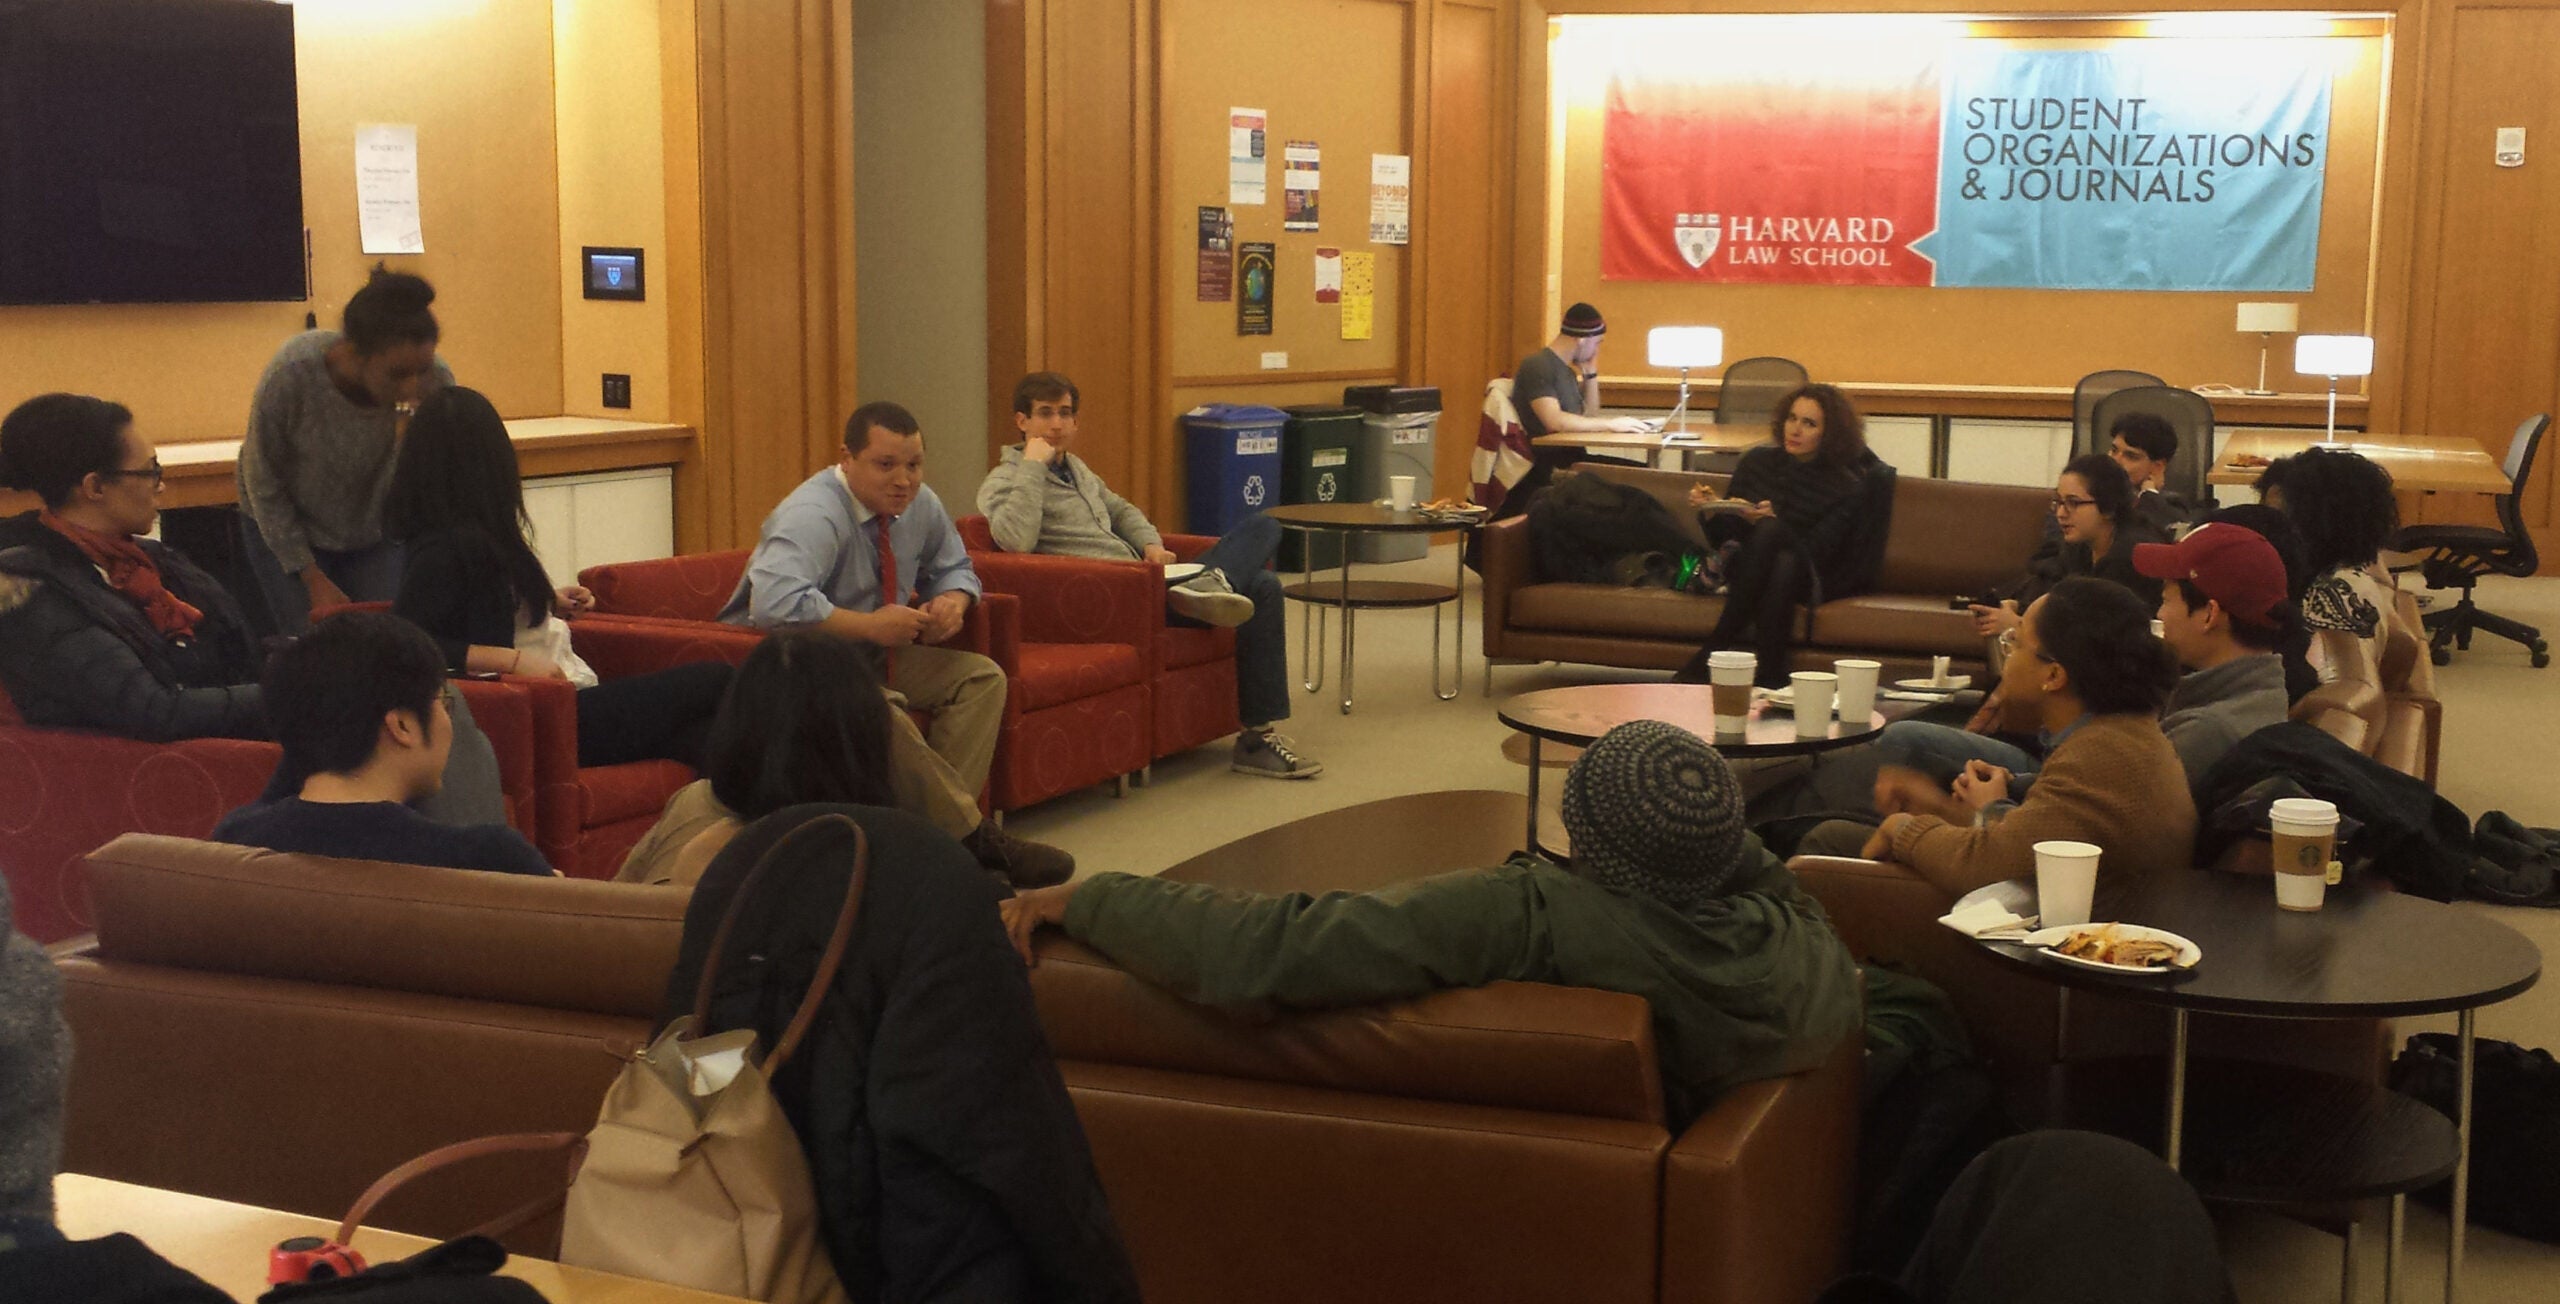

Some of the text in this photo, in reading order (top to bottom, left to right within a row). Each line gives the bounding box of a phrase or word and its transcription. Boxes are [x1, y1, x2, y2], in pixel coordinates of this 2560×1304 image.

[1966, 97, 2146, 130] STUDENT
[1963, 132, 2315, 167] ORGANIZATIONS
[1961, 168, 2215, 203] & JOURNALS
[1729, 216, 1894, 243] HARVARD
[1729, 247, 1892, 267] LAW SCHOOL
